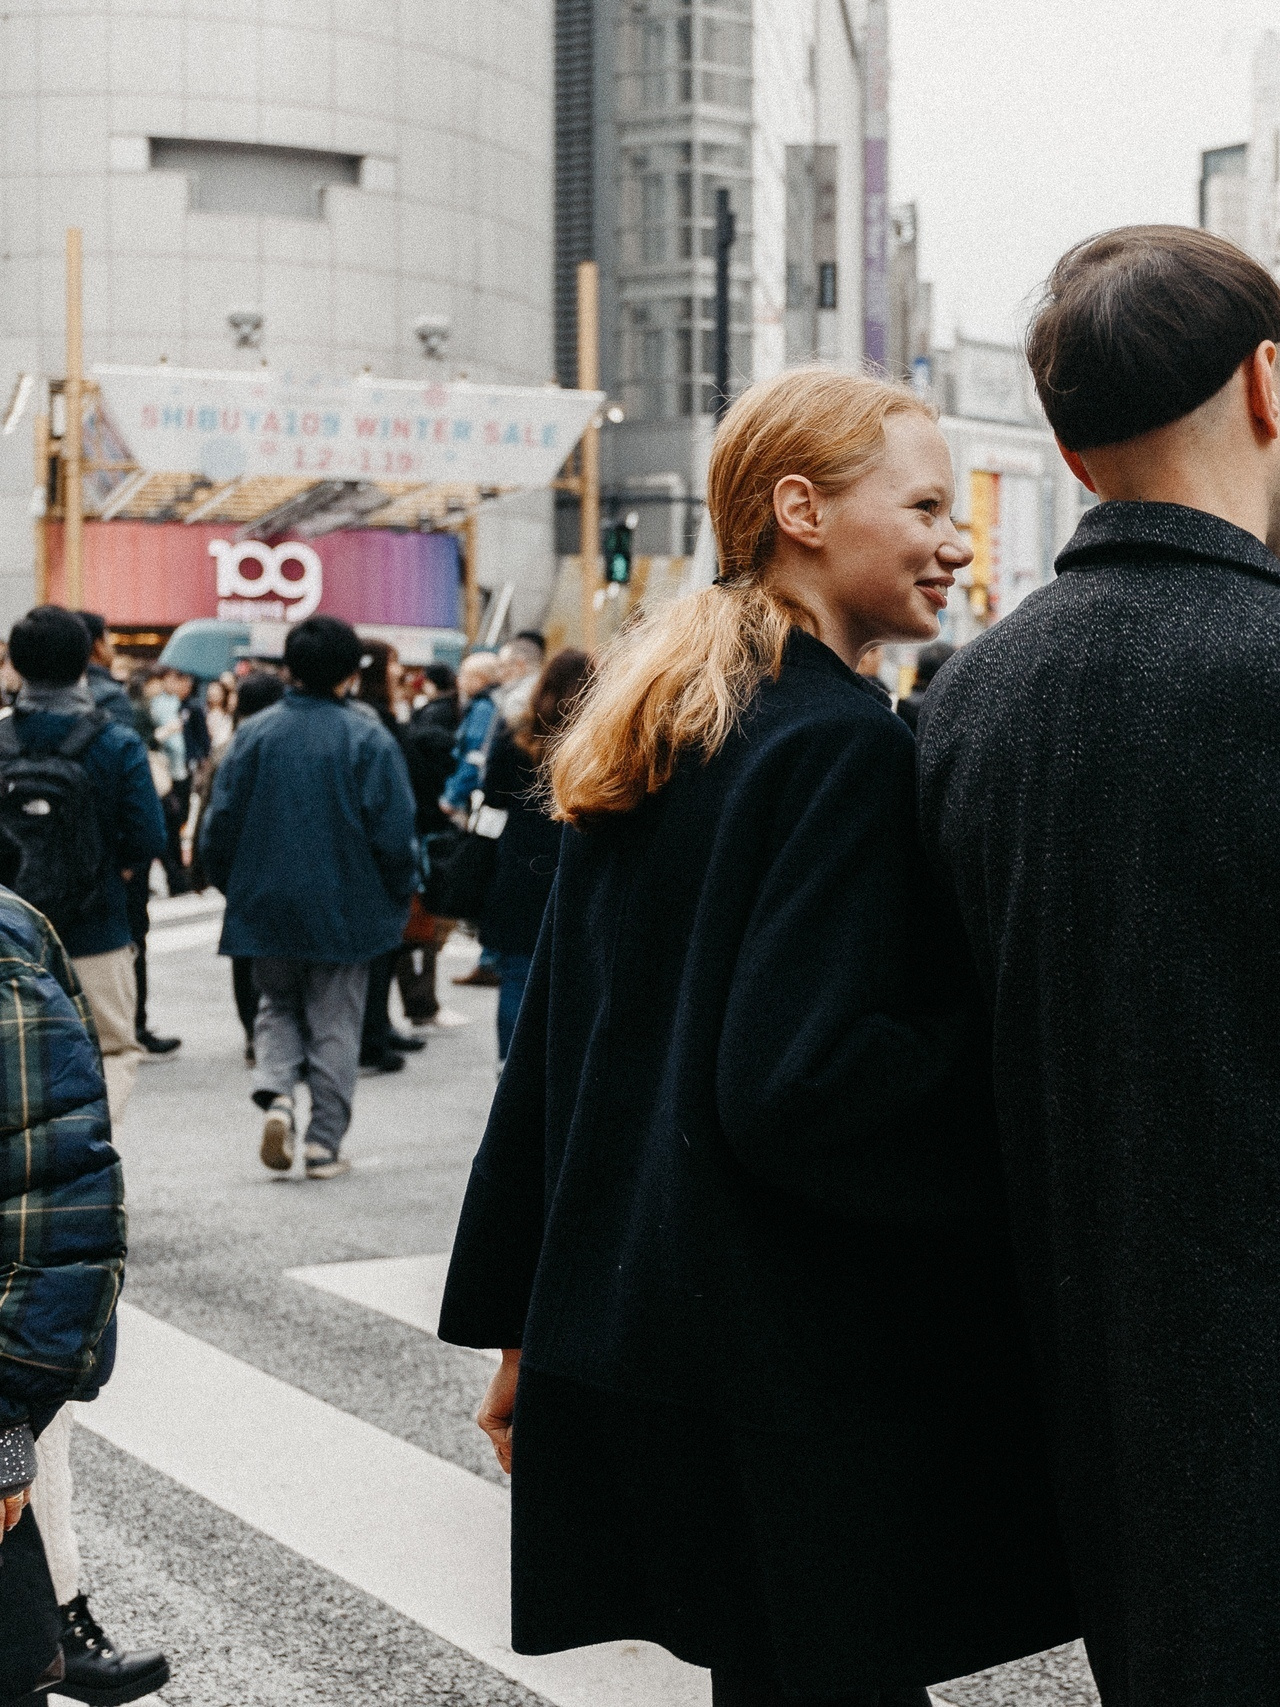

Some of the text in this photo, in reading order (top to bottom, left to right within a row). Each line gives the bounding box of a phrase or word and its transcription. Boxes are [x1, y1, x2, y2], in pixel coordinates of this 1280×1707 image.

[141, 405, 557, 448] SHIBUYA109 WINTER SALE
[207, 538, 322, 622] 109
